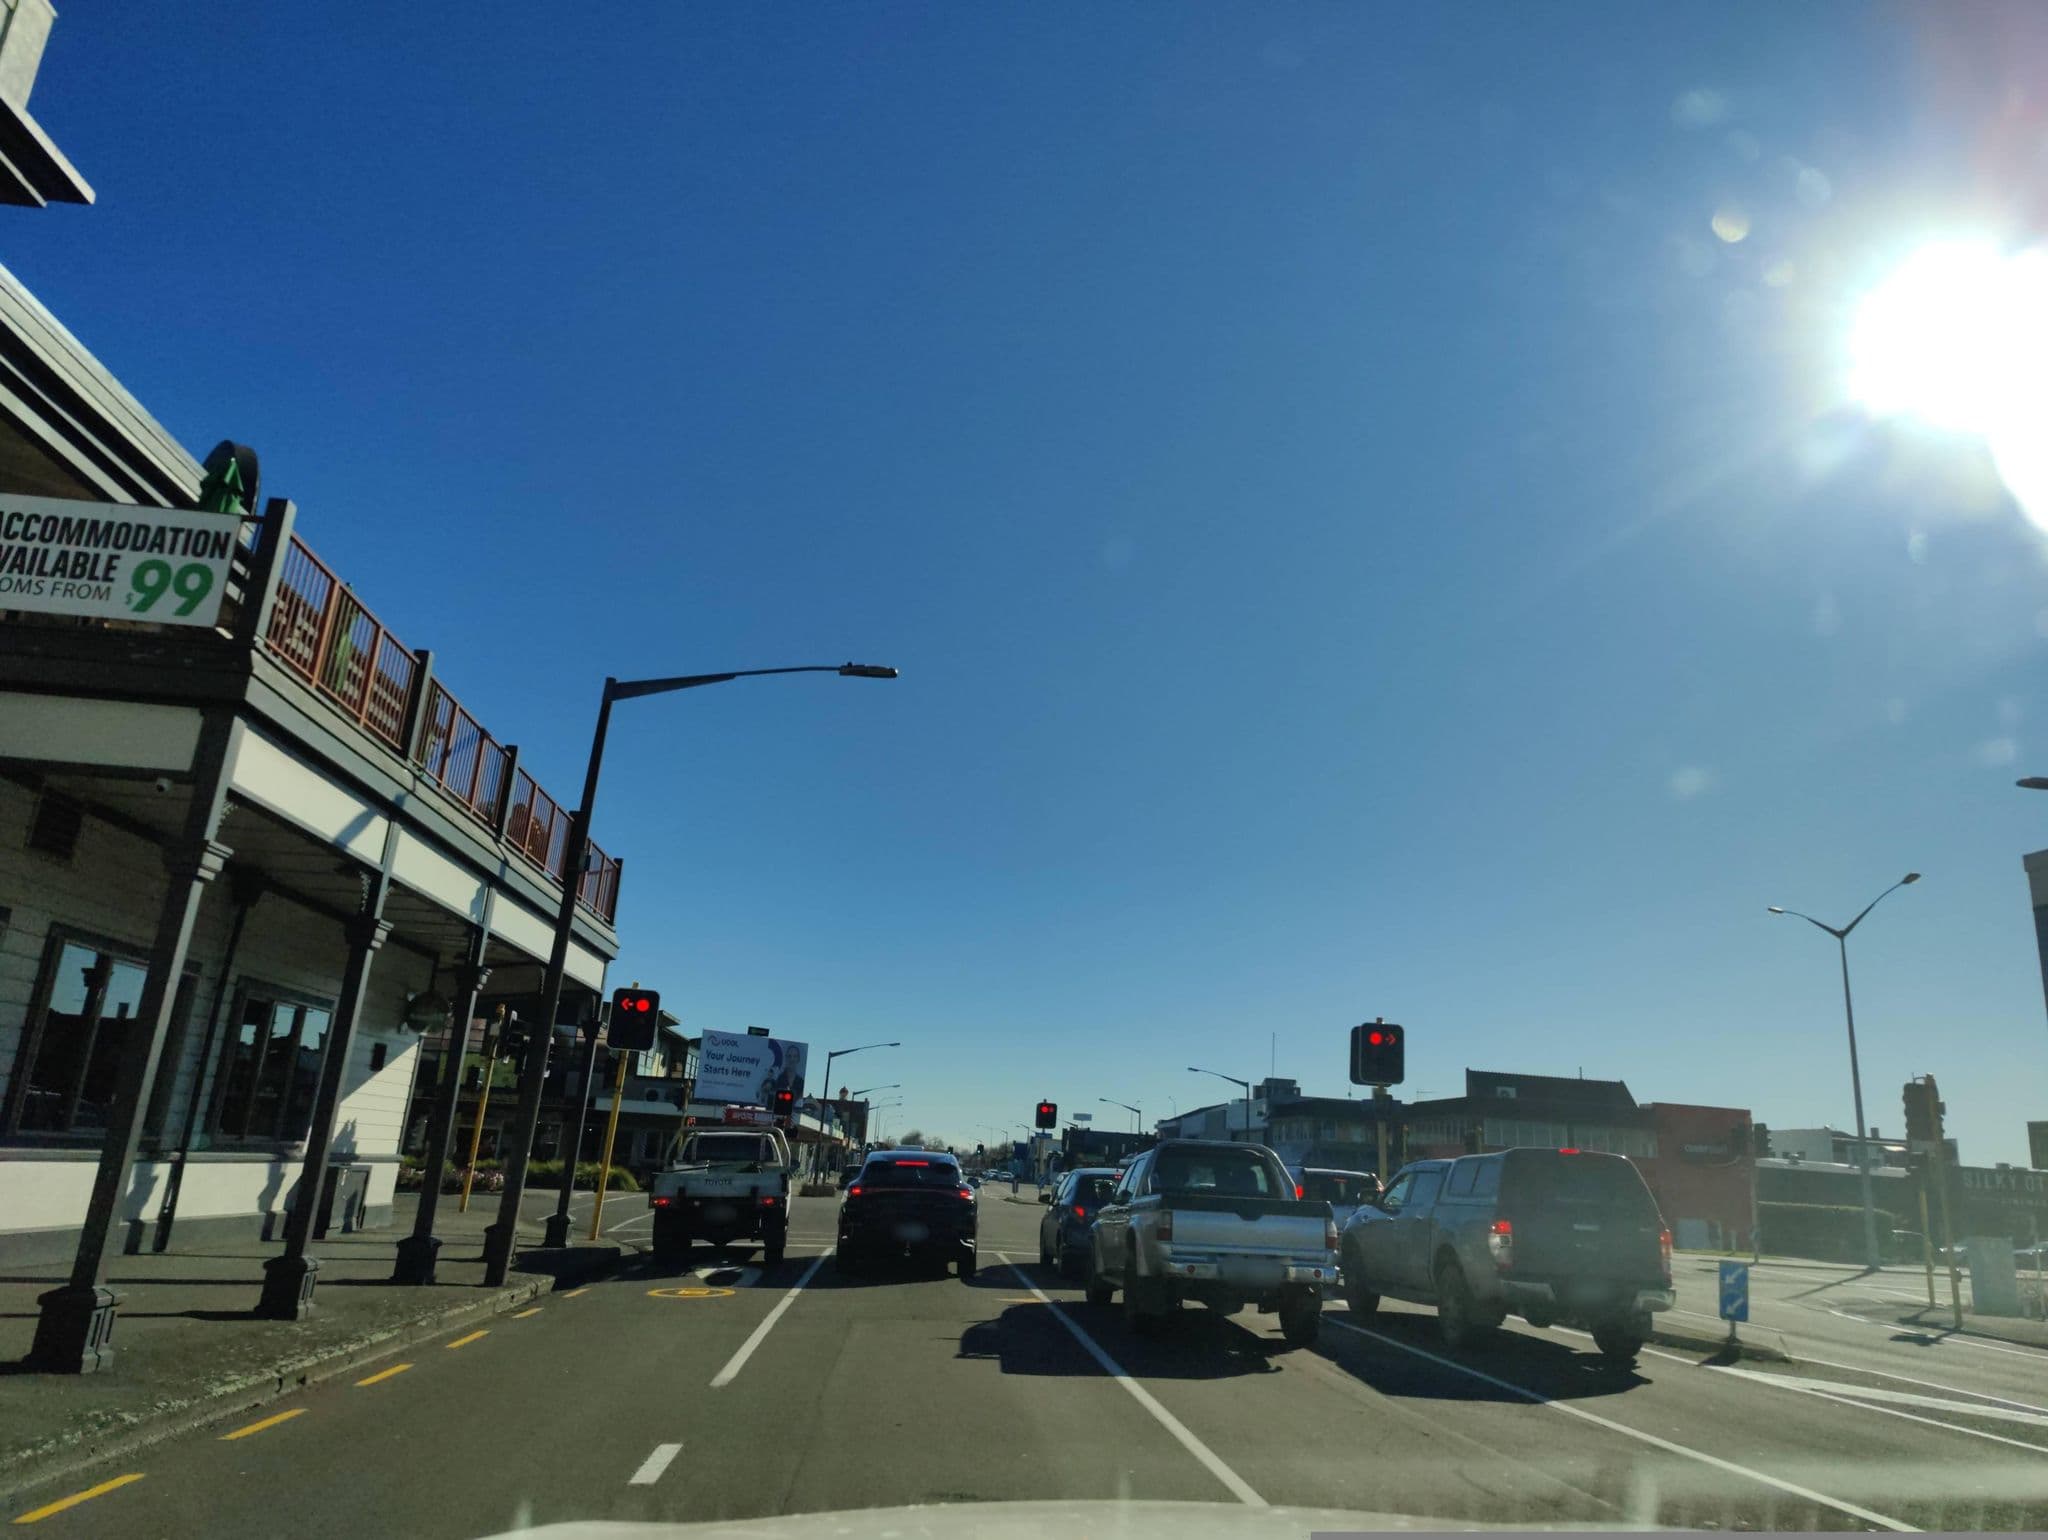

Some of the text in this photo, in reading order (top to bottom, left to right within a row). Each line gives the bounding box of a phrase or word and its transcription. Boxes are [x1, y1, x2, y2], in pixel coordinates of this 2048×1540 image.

[0, 511, 231, 559] CCOMMODATION
[50, 581, 112, 601] FROM
[125, 559, 214, 616] $99
[706, 1049, 761, 1067] Your Journey
[703, 1063, 752, 1078] Starts Here
